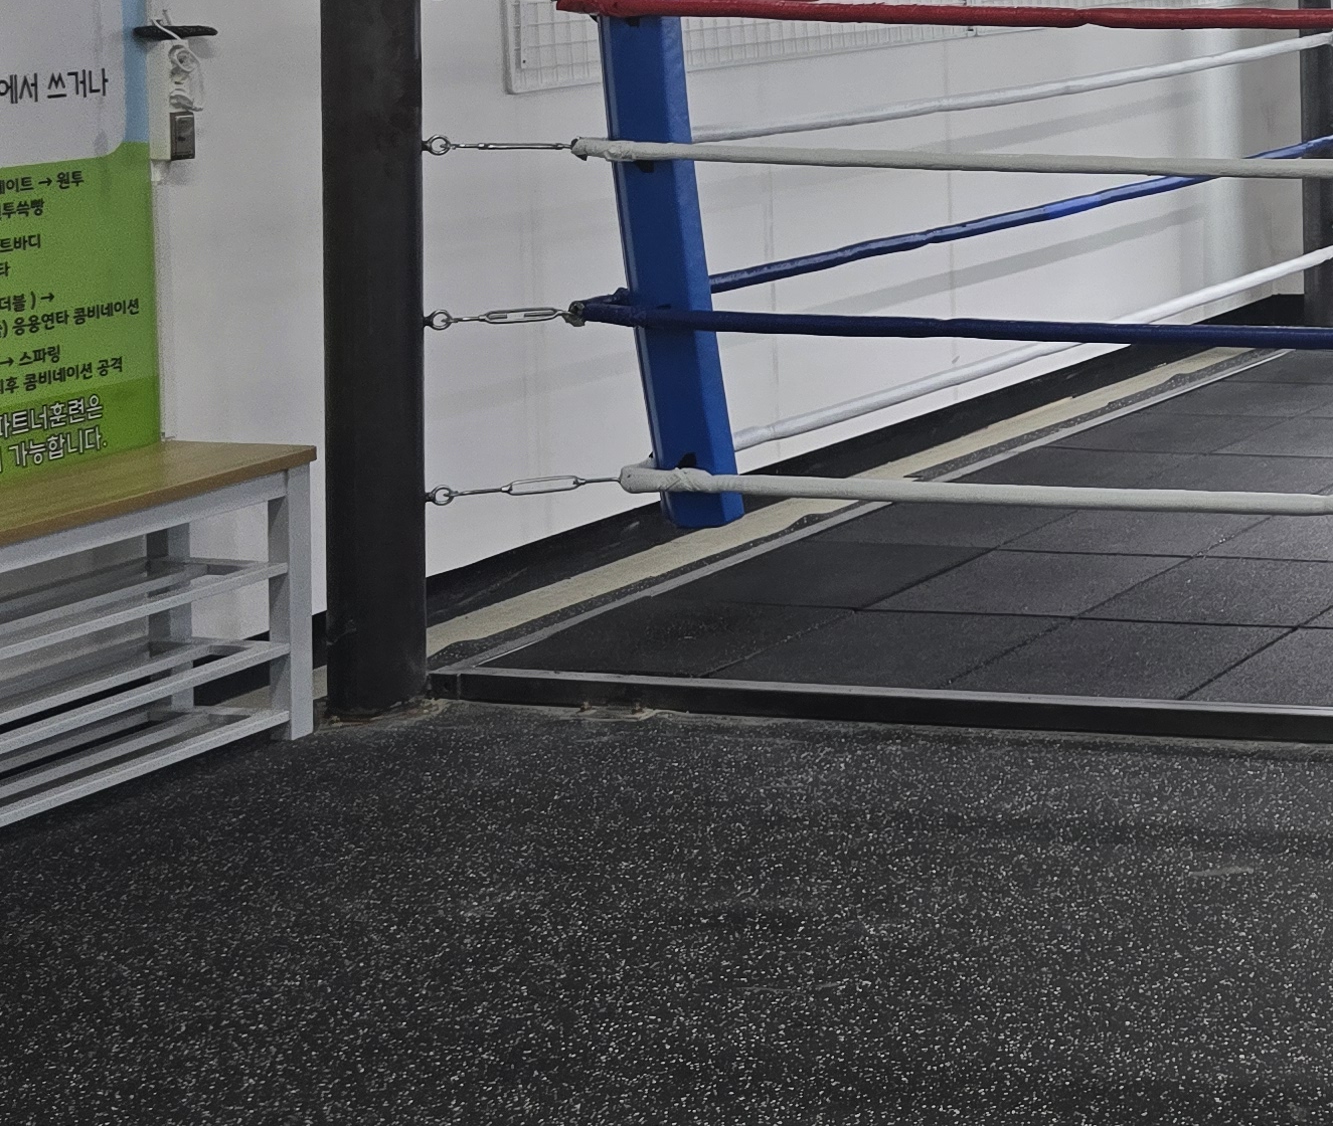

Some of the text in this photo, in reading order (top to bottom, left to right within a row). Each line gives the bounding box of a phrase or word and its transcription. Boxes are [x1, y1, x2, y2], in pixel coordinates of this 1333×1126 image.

[0, 68, 109, 104] 에서 쓰거나
[56, 171, 84, 189] 원투
[0, 198, 45, 221] 투쓱빵
[12, 310, 69, 335] 응용연타
[19, 344, 60, 366] 스파링
[23, 362, 93, 391] 콤비네이션
[97, 356, 123, 376] 공격
[8, 425, 107, 467] 가능합니다.
